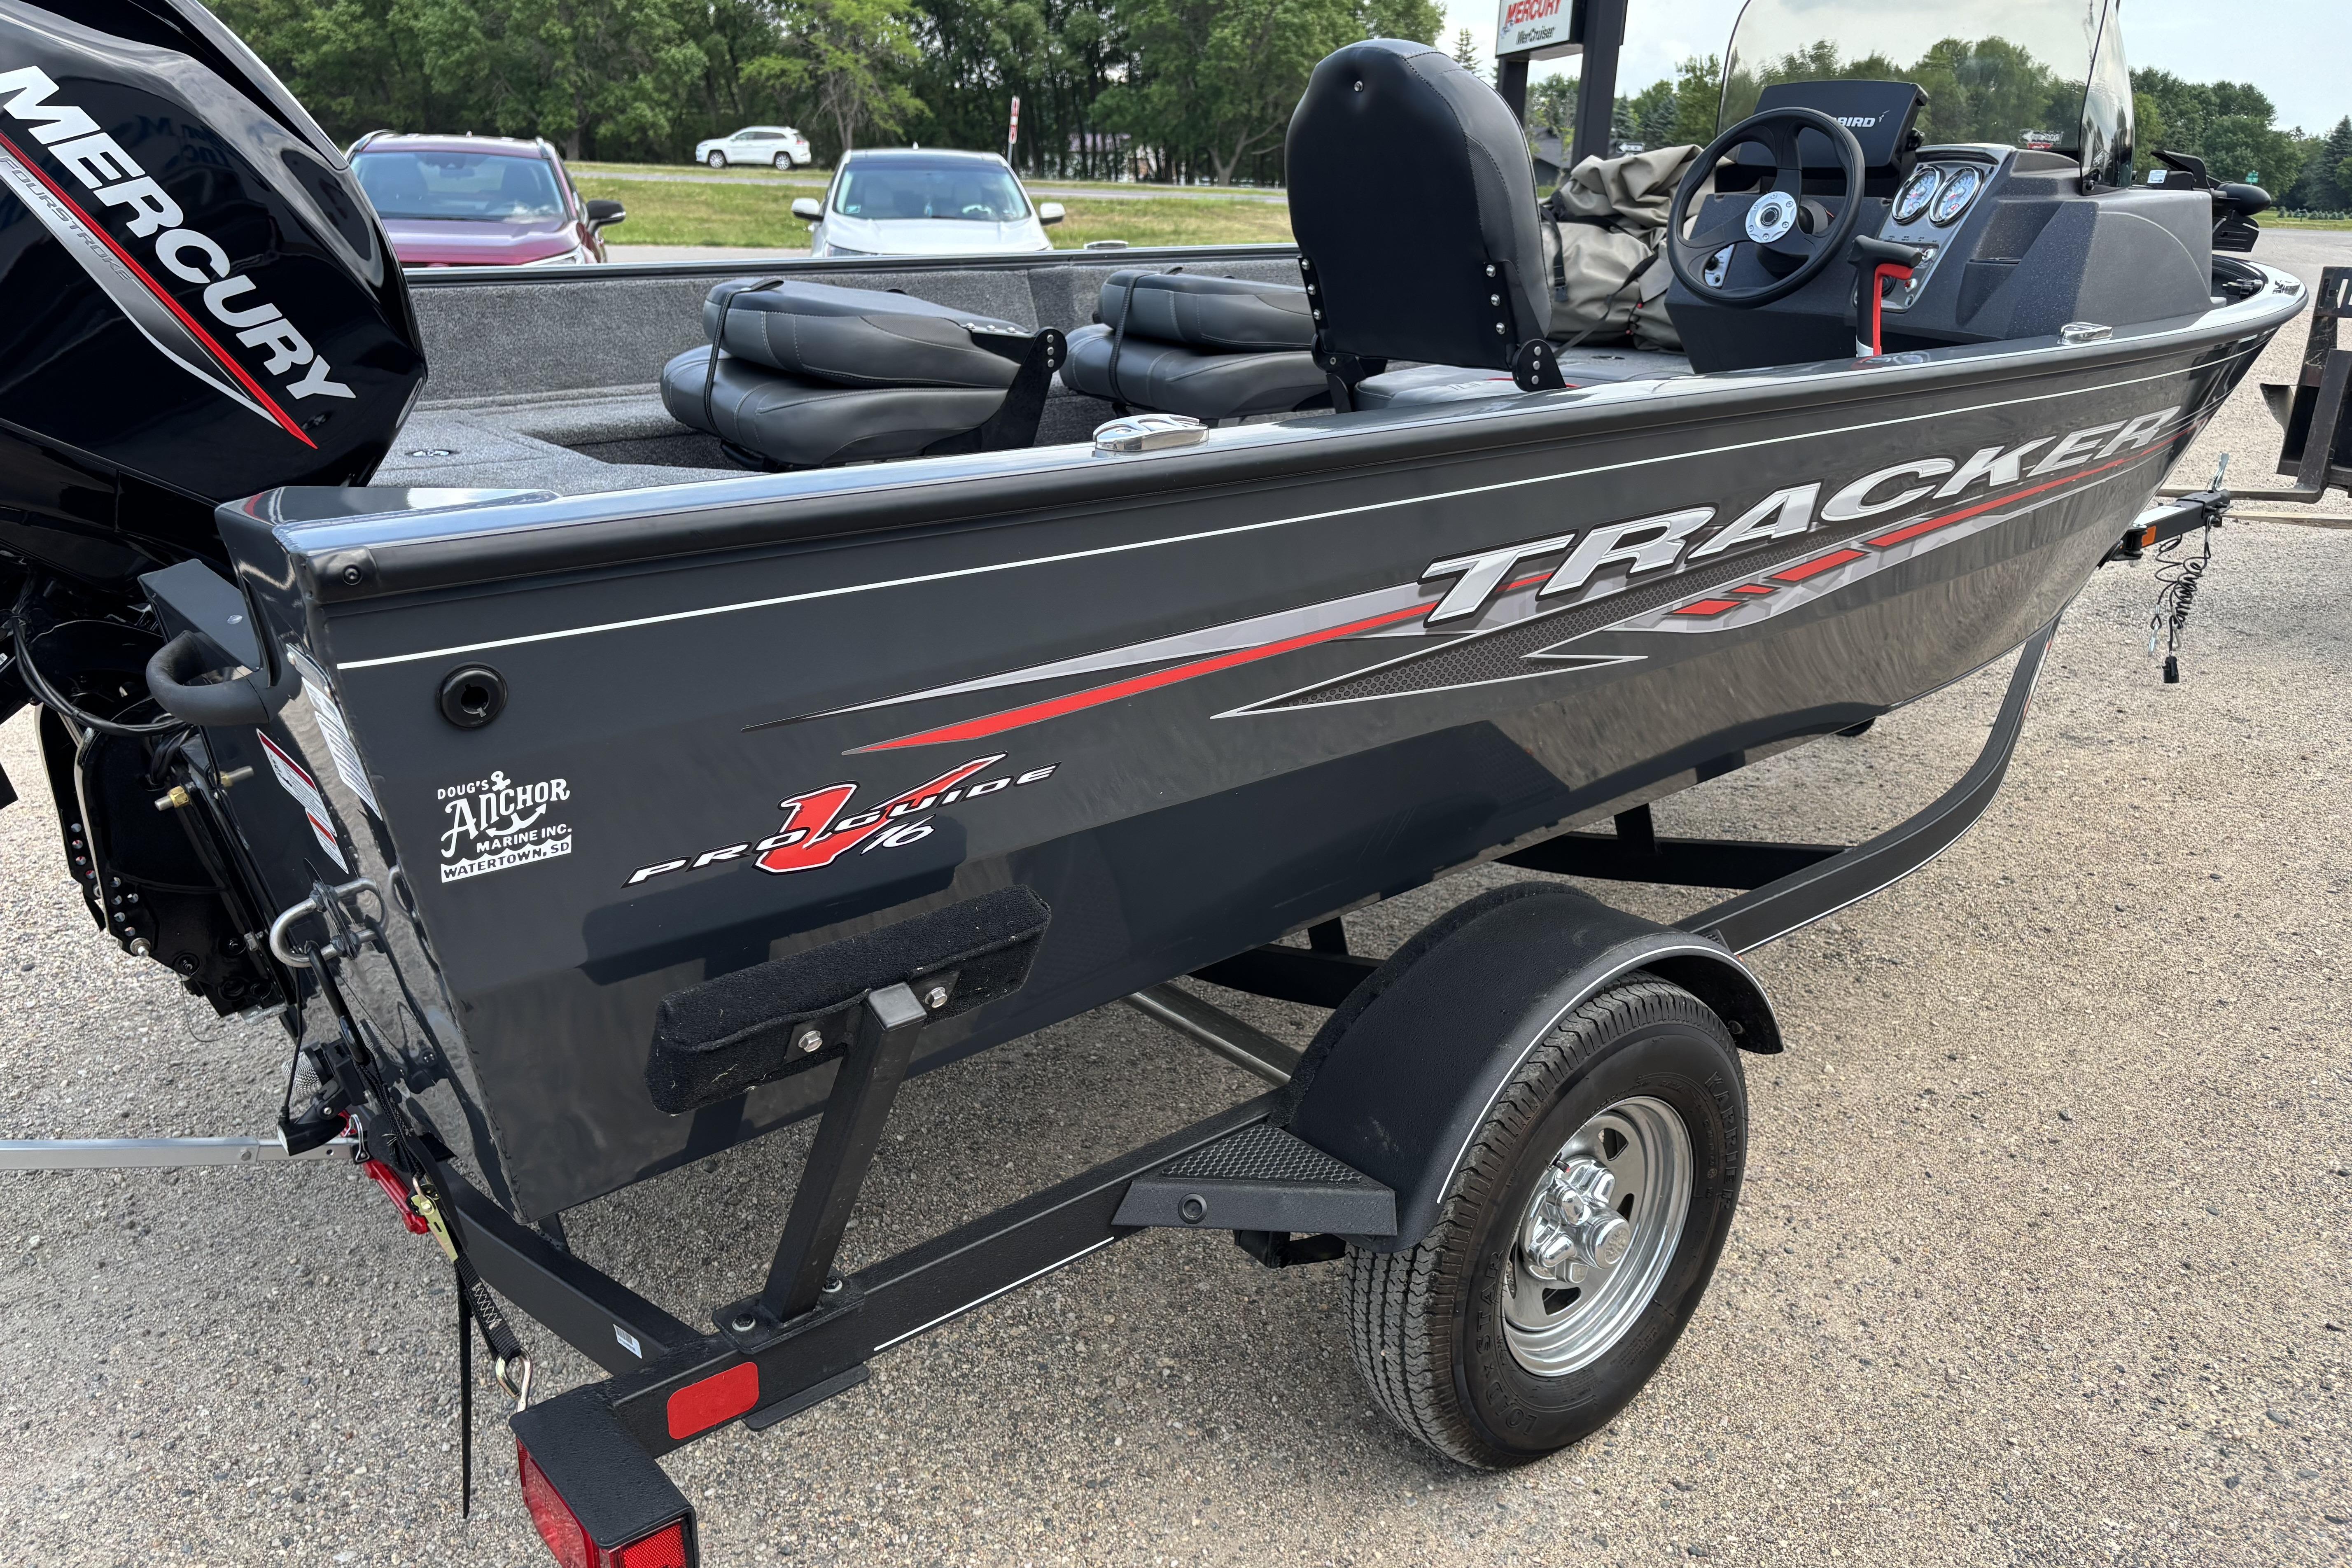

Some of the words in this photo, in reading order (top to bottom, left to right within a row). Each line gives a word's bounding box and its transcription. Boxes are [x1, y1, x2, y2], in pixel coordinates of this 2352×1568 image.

[1505, 0, 1561, 26] MERCURY
[1834, 117, 1876, 127] BIRD
[0, 156, 132, 281] FOURSTROKE
[0, 66, 357, 399] MERCURY
[1419, 405, 2180, 627] TRACKER
[437, 779, 489, 800] DOUG'S
[476, 830, 538, 853] MARINE
[541, 824, 572, 838] INC.
[621, 829, 811, 888] PRO
[828, 761, 1061, 836] GUIDE
[860, 814, 937, 856] 16
[445, 847, 547, 878] WATERTOWN,
[551, 842, 569, 854] SD
[1705, 1071, 1738, 1211] KARRIER
[1477, 1249, 1504, 1354] STAR
[1486, 1381, 1538, 1435] LOAD
